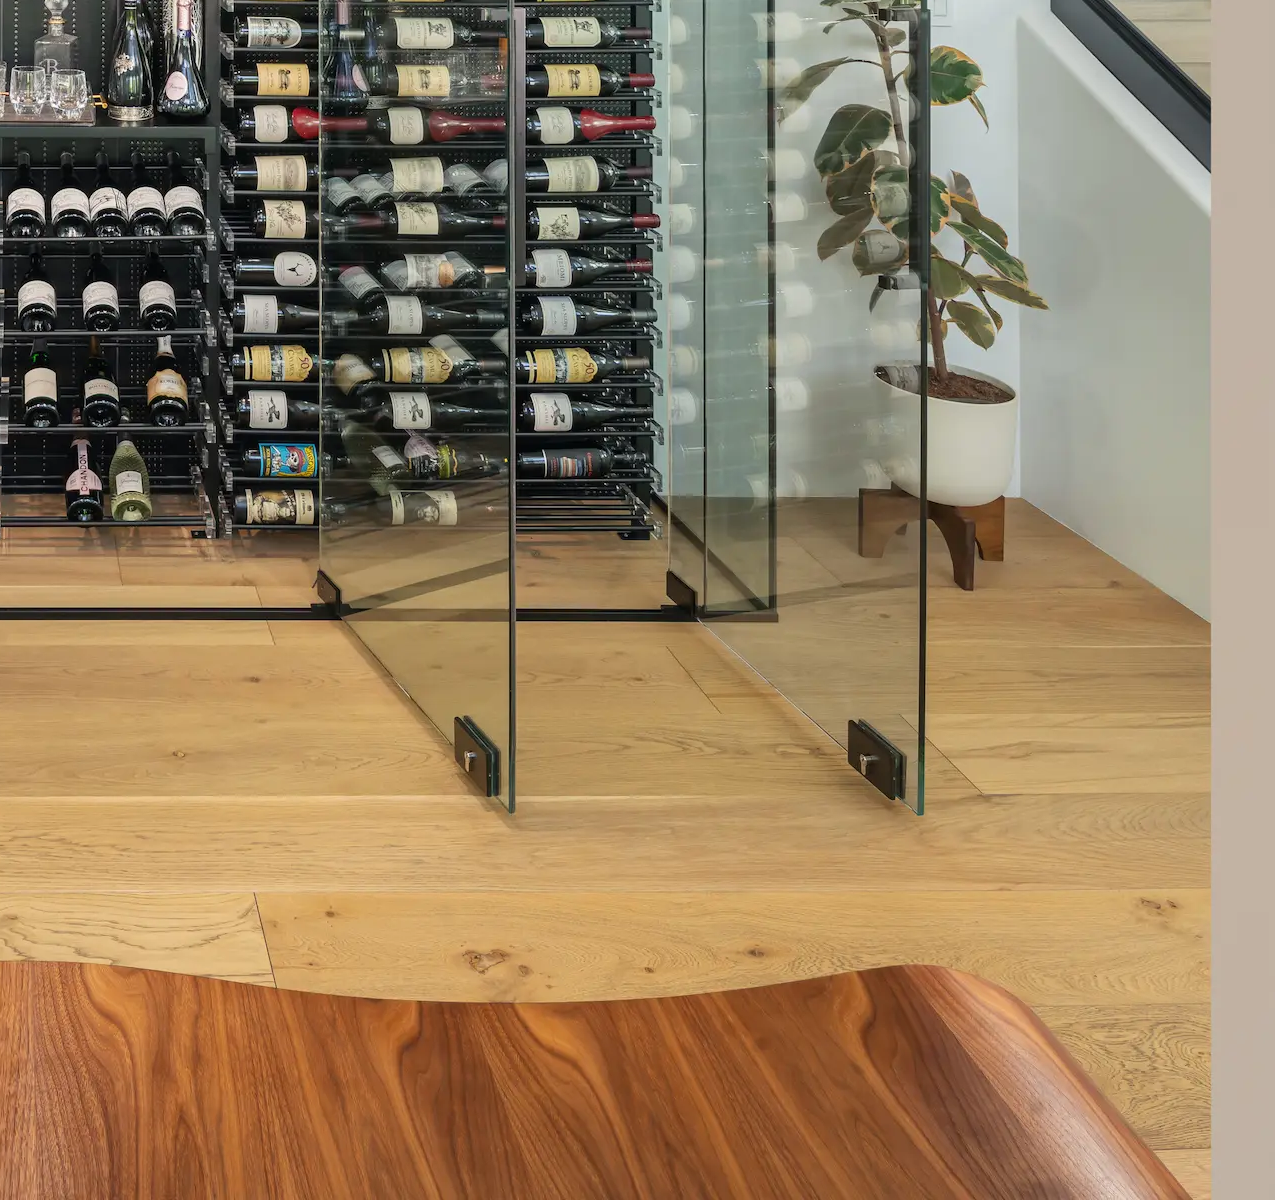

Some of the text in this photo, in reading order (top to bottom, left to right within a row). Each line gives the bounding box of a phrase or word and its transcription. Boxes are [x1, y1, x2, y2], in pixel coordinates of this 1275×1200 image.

[556, 254, 564, 281] MEIOMI
[287, 349, 295, 377] CAYMUS
[300, 355, 310, 370] 50
[438, 356, 449, 371] 50
[584, 361, 595, 376] 50
[79, 454, 88, 492] CHANDON
